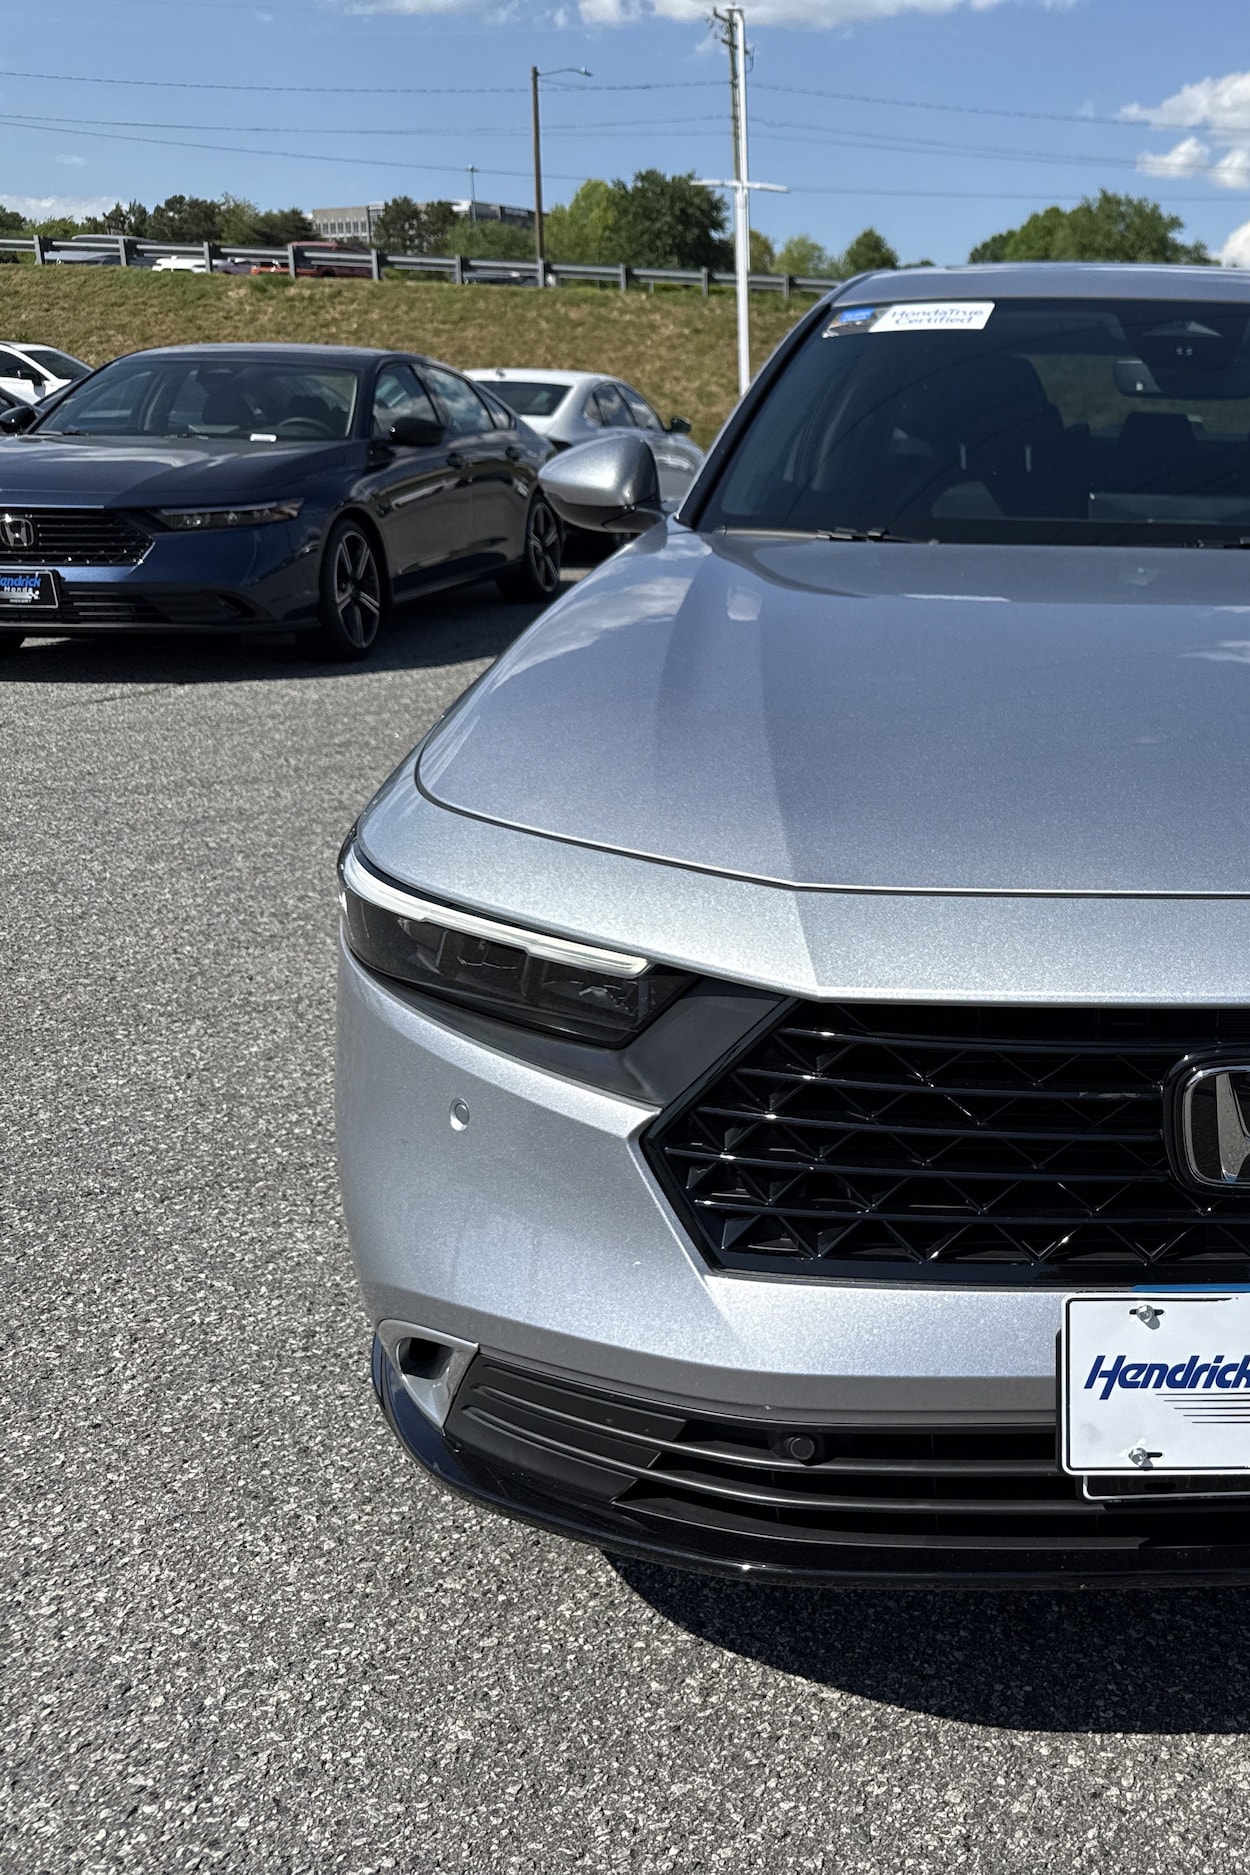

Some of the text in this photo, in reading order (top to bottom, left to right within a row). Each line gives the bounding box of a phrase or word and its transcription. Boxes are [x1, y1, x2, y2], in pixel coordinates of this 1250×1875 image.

[891, 308, 984, 318] HondaTrue
[894, 316, 973, 325] Certified
[0, 574, 41, 588] endrick
